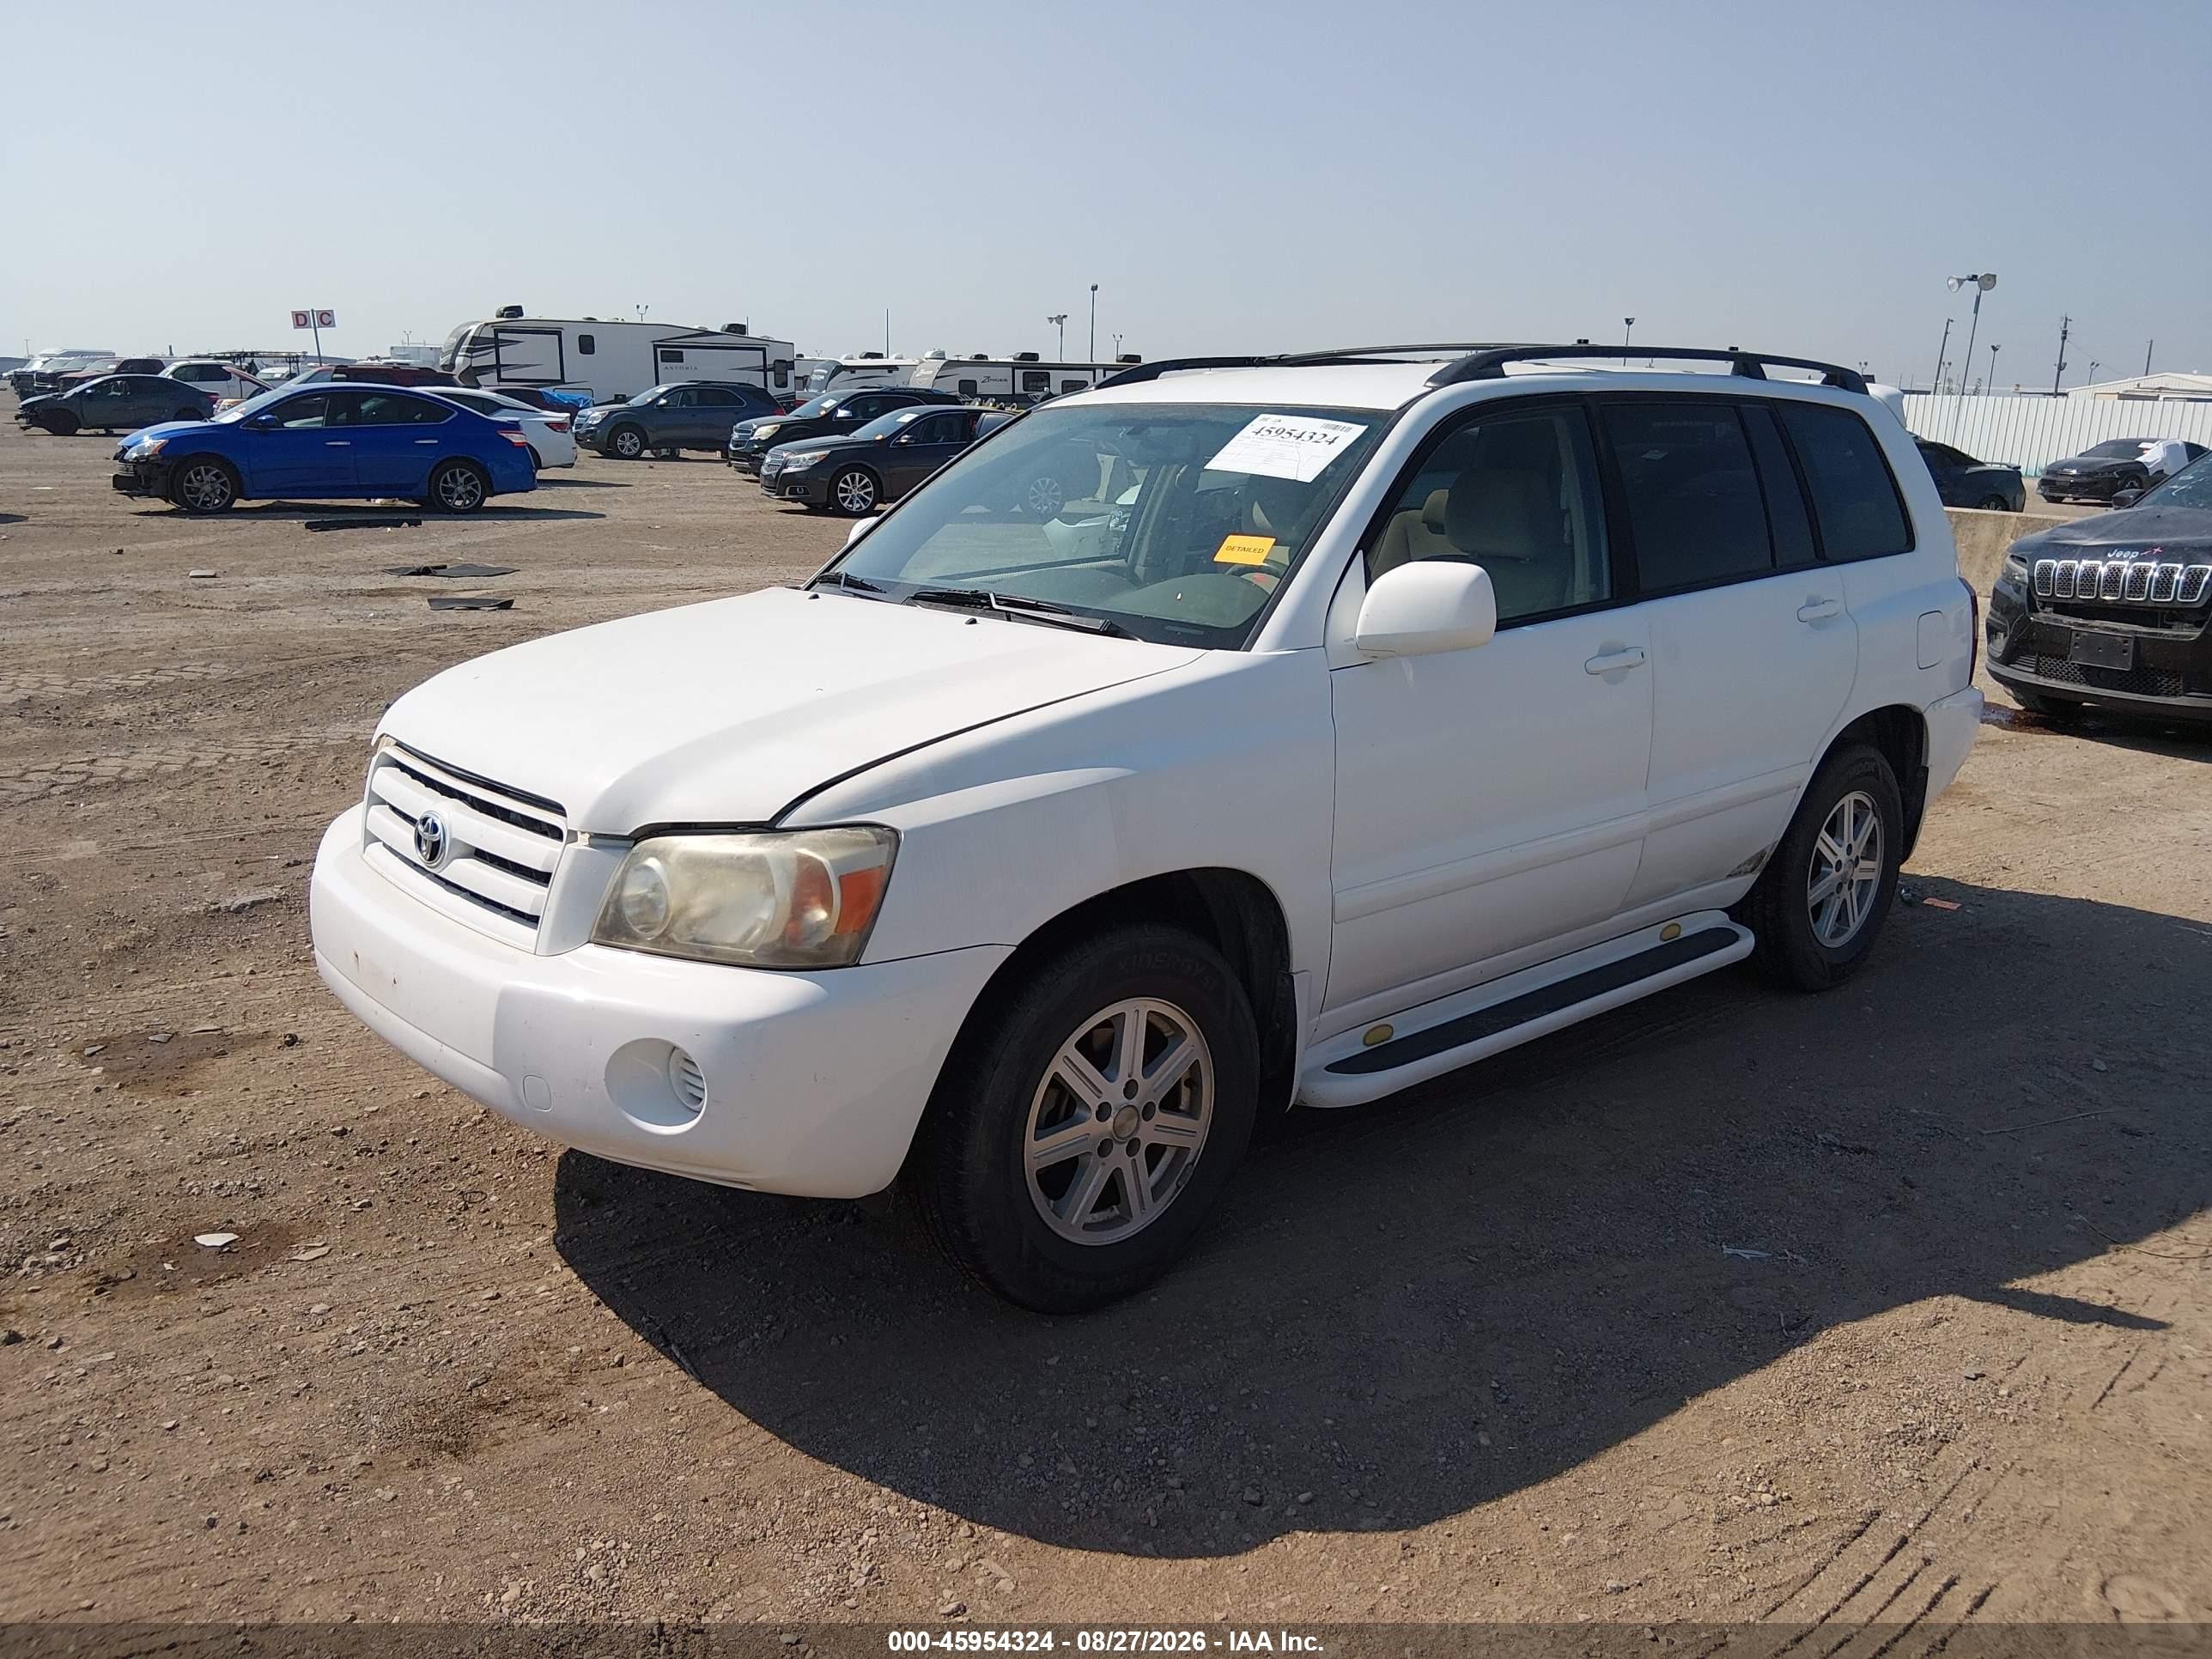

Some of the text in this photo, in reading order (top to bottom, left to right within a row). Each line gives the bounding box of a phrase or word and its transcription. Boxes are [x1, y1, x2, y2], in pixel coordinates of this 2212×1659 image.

[295, 312, 331, 326] D C
[1252, 426, 1340, 445] 45954324
[1225, 545, 1264, 554] DETAILED
[2107, 549, 2140, 559] Jeep
